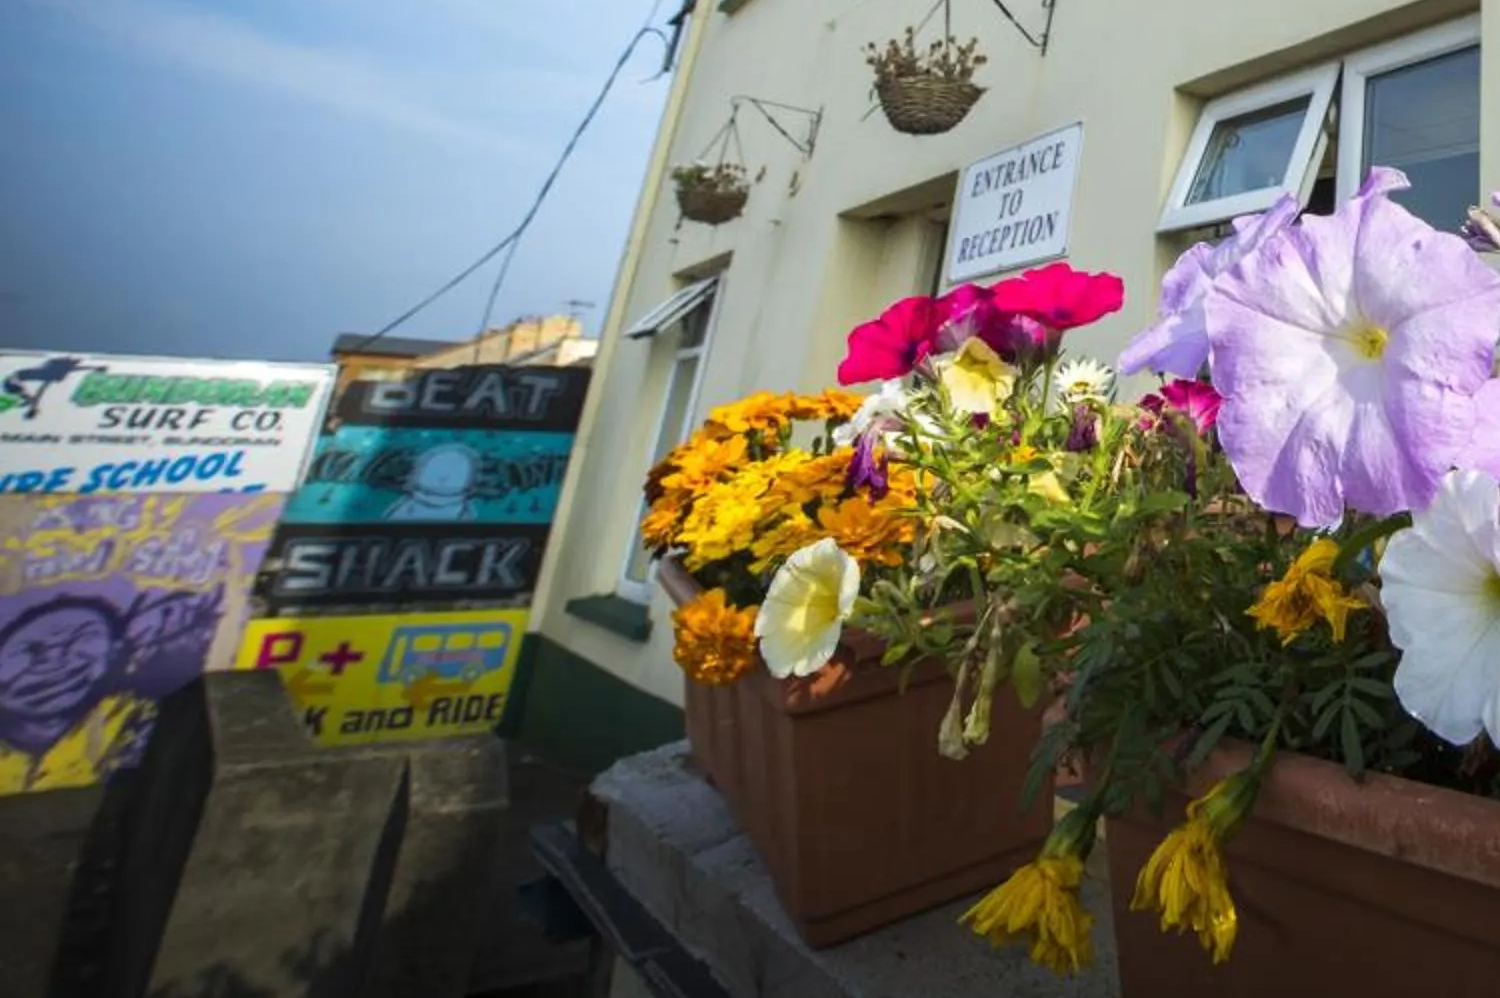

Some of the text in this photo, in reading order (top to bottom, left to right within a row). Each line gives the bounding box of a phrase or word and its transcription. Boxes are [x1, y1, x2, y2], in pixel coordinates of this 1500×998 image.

[971, 141, 1065, 198] ENTRANCE
[998, 188, 1024, 221] TO
[957, 210, 1059, 264] RECEPTION
[366, 371, 562, 414] BEAT
[97, 406, 215, 430] SURF
[79, 450, 245, 494] SCHOOL
[282, 542, 525, 590] SHACK
[339, 705, 414, 734] and
[426, 692, 504, 728] RIDE
